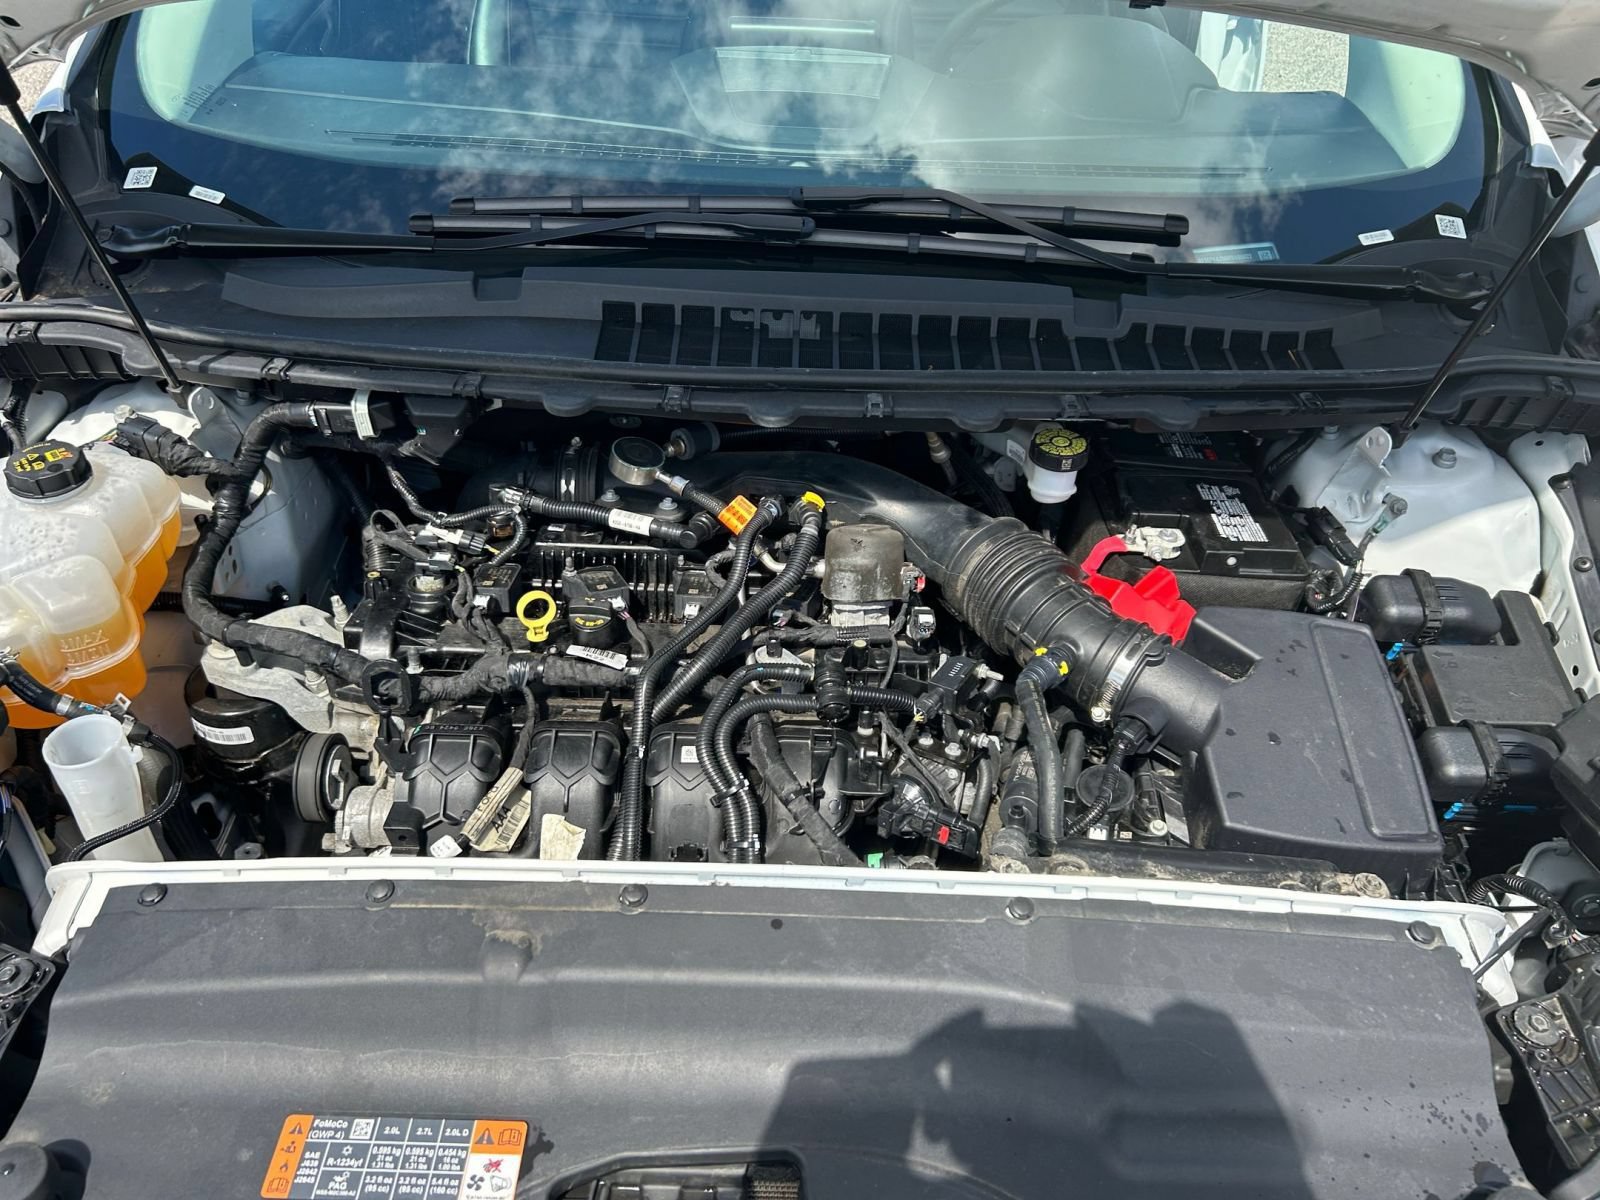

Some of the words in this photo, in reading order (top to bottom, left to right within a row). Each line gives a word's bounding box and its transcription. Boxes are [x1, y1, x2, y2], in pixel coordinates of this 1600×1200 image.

[490, 806, 511, 833] AAA
[313, 1119, 348, 1128] FoMoCo
[308, 1130, 334, 1139] (GWP
[335, 1130, 345, 1140] 4)
[392, 1147, 402, 1157] kg
[425, 1148, 434, 1158] kg
[457, 1149, 467, 1158] kg
[326, 1158, 364, 1168] R-1234yf
[411, 1186, 423, 1194] cc)
